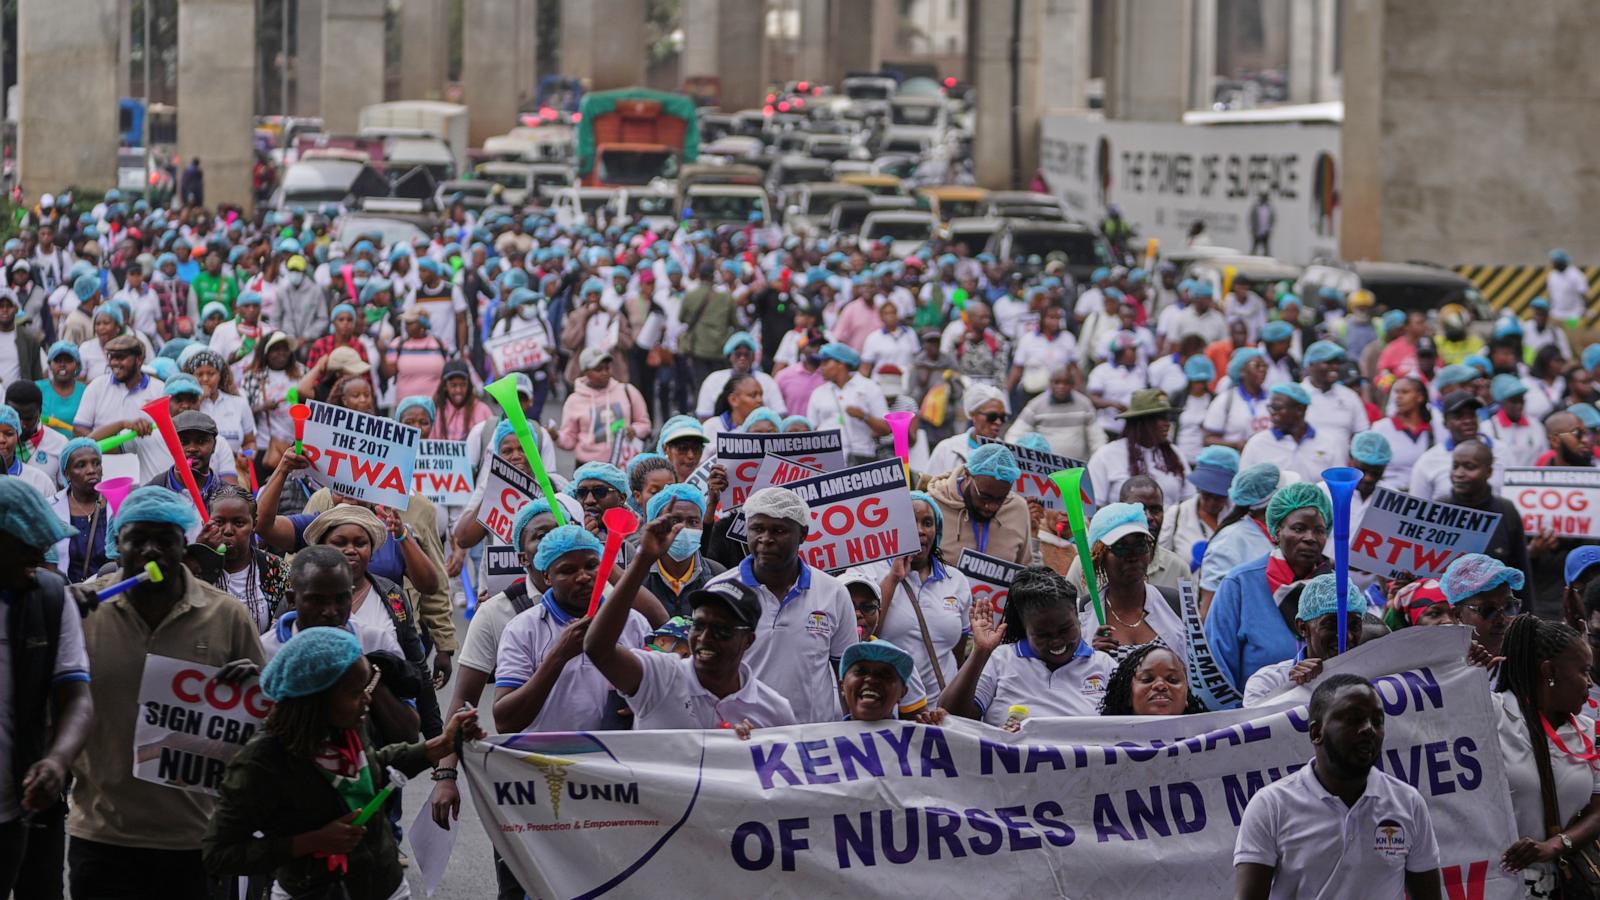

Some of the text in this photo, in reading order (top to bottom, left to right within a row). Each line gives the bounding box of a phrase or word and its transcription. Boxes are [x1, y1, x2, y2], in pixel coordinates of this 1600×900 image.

[307, 402, 418, 448] IMPLEMENT
[332, 432, 390, 459] THE 2017
[420, 443, 467, 457] LEMENT
[718, 434, 841, 454] PUNDA AMECHOKA
[980, 438, 1085, 469] IPLEMENT
[302, 443, 406, 496] RTWA
[432, 459, 453, 471] 2017
[492, 458, 529, 493] PUNDA
[1017, 461, 1034, 472] HE
[333, 481, 356, 496] NOW
[412, 473, 473, 497] TWA
[790, 483, 819, 502] NDA
[820, 464, 904, 499] AMECHOKA
[1373, 489, 1497, 533] IMPLEMENT
[1519, 489, 1589, 512] COG
[1397, 521, 1462, 547] THE 2017
[1521, 514, 1592, 535] CT NOW
[489, 551, 523, 569] PUN
[799, 528, 899, 572] CT NOW
[960, 554, 1003, 580] PUNDA
[1183, 586, 1242, 706] IMPLEMENT
[1188, 652, 1203, 689] 2017
[172, 668, 276, 719] COG
[145, 701, 203, 735] SIGN
[751, 725, 959, 790] KENYA
[1286, 666, 1443, 733] UON
[158, 747, 226, 790] NUR
[493, 780, 640, 806] KN UNM
[730, 737, 1482, 872] OF NURSES AND MVES
[526, 822, 571, 832] Protection
[573, 821, 581, 830] &
